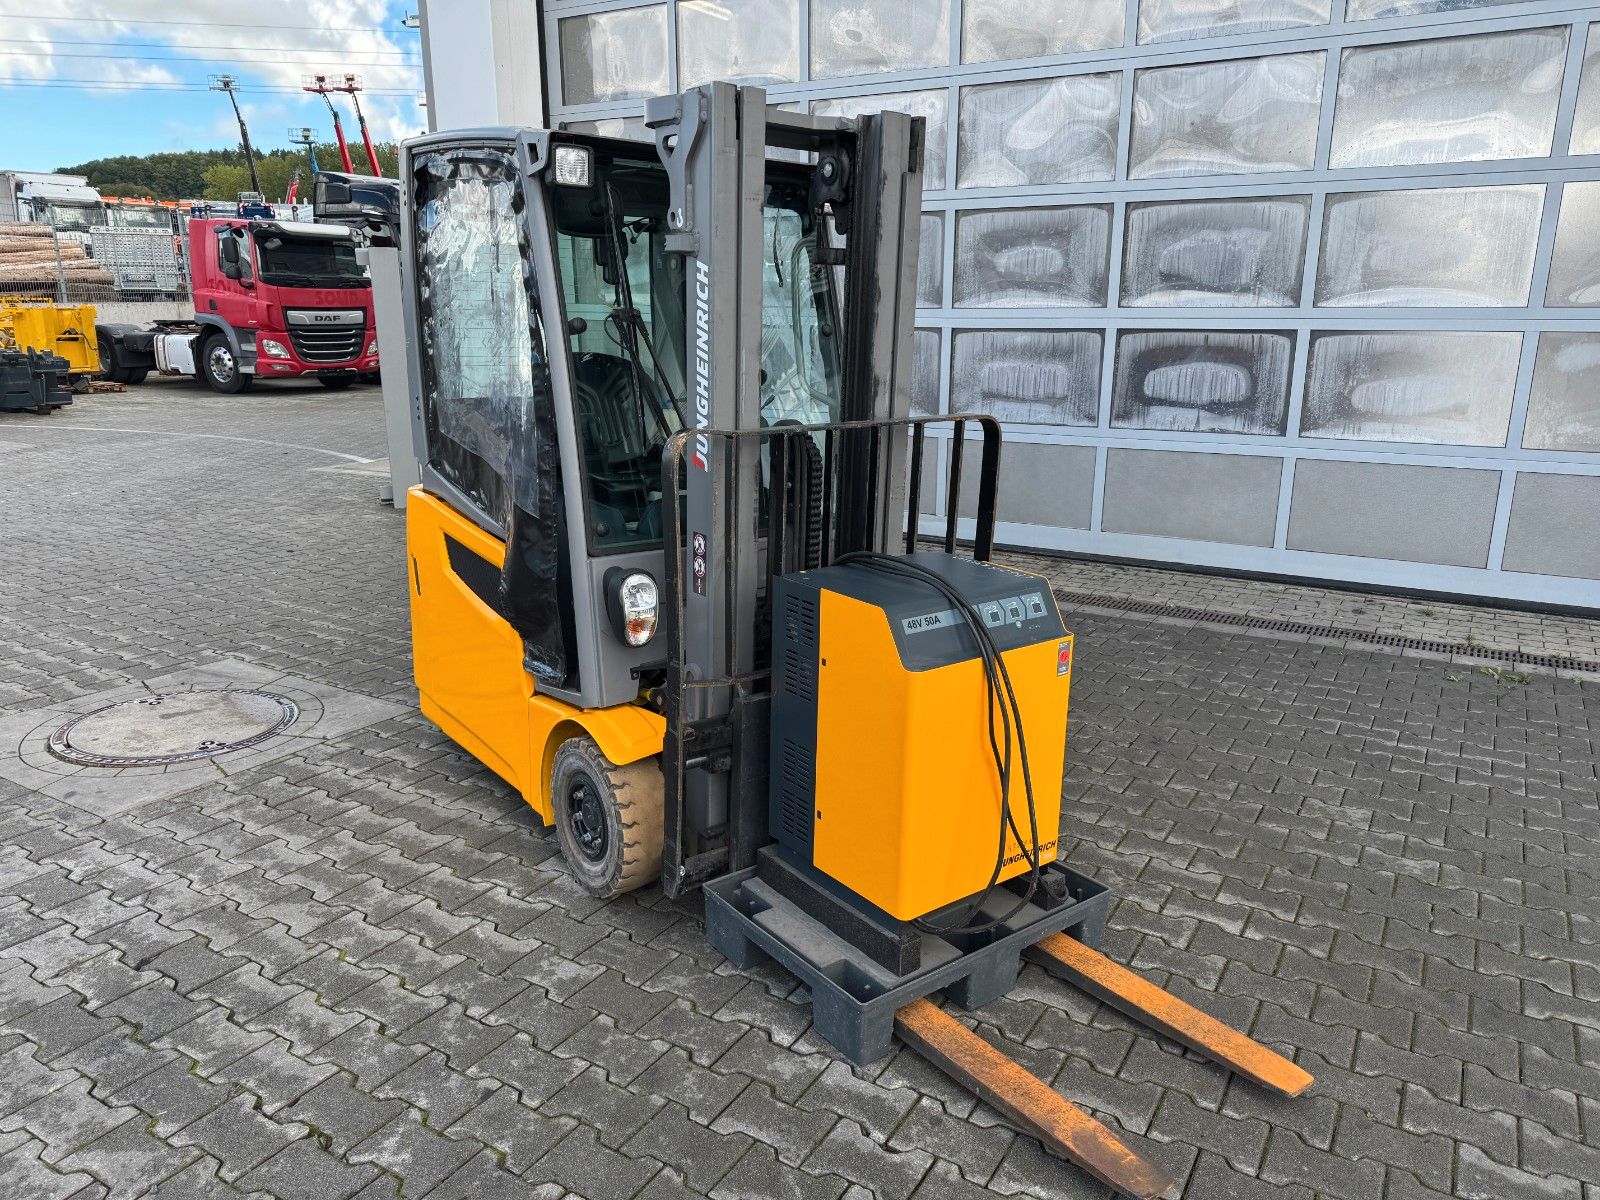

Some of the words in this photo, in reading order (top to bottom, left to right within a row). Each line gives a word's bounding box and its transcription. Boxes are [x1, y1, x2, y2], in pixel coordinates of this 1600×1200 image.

[692, 260, 709, 473] JUNGHEINRICH
[907, 618, 922, 629] 48V
[924, 615, 942, 626] 50A
